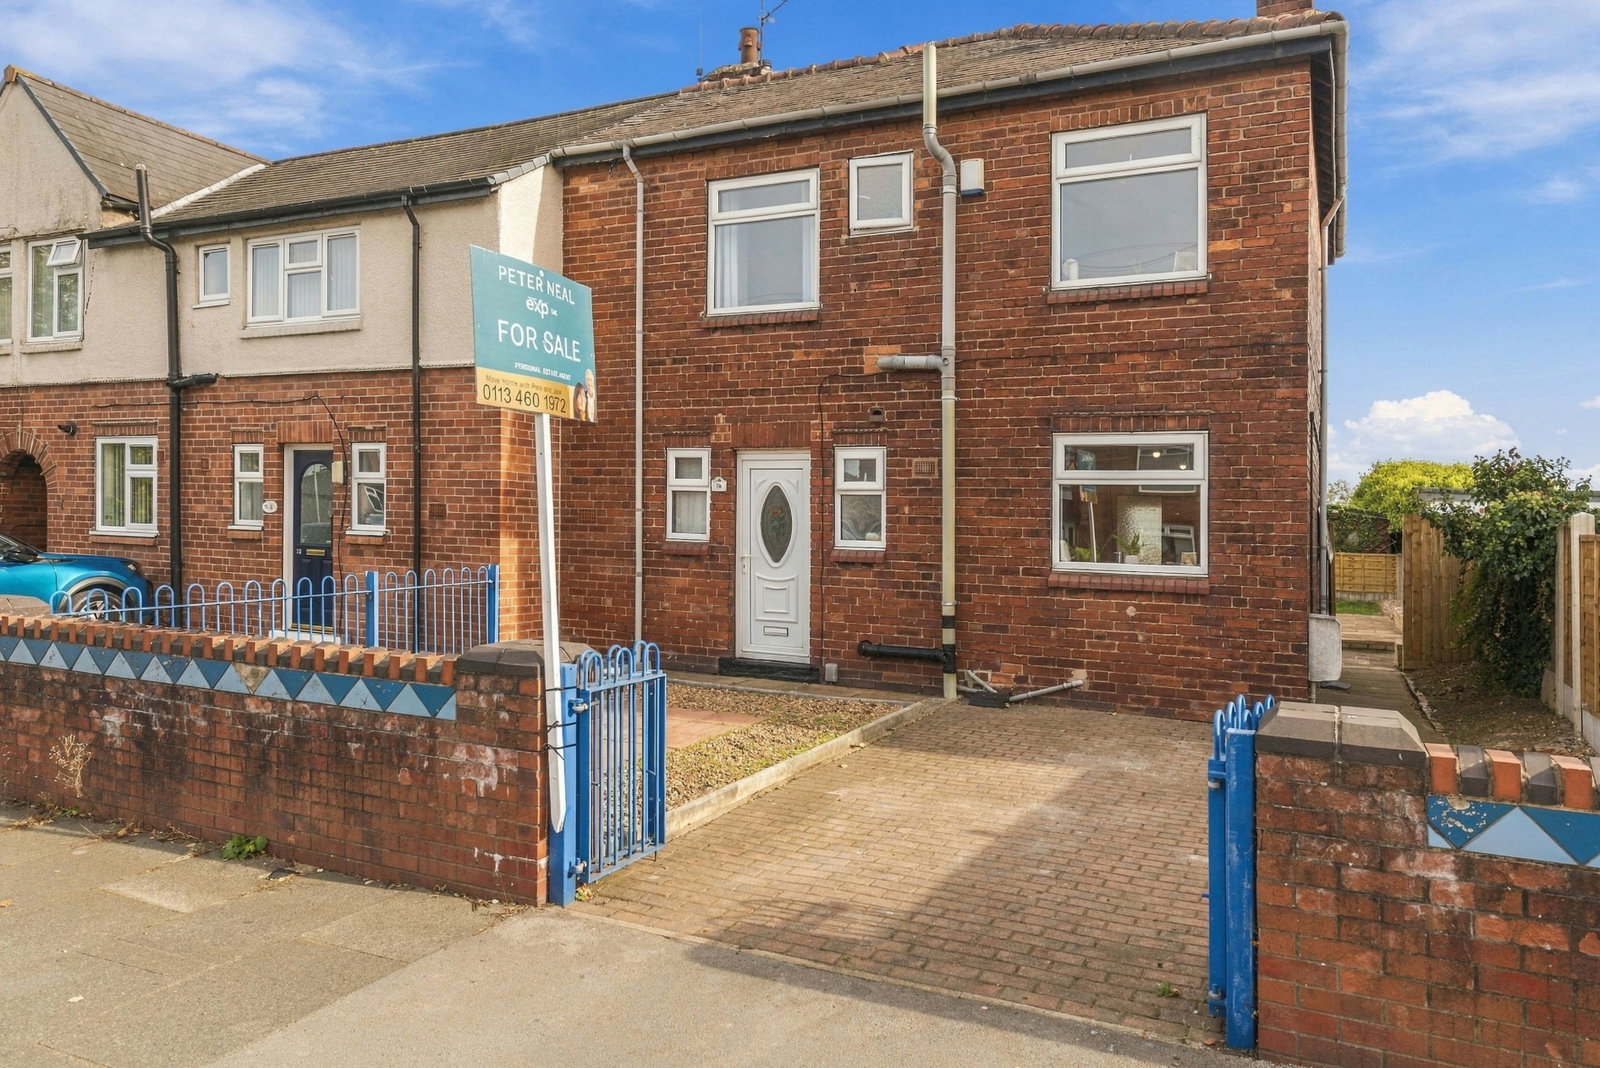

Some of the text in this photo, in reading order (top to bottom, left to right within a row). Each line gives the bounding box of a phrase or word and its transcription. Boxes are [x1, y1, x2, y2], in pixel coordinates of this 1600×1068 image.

[498, 265, 575, 304] PETER NEAL
[526, 296, 549, 319] exp
[498, 319, 581, 362] FOR SALE
[486, 375, 500, 383] Move
[514, 362, 541, 373] PERSONAL
[558, 372, 571, 381] AGENT
[483, 384, 566, 414] 0113 460 1972
